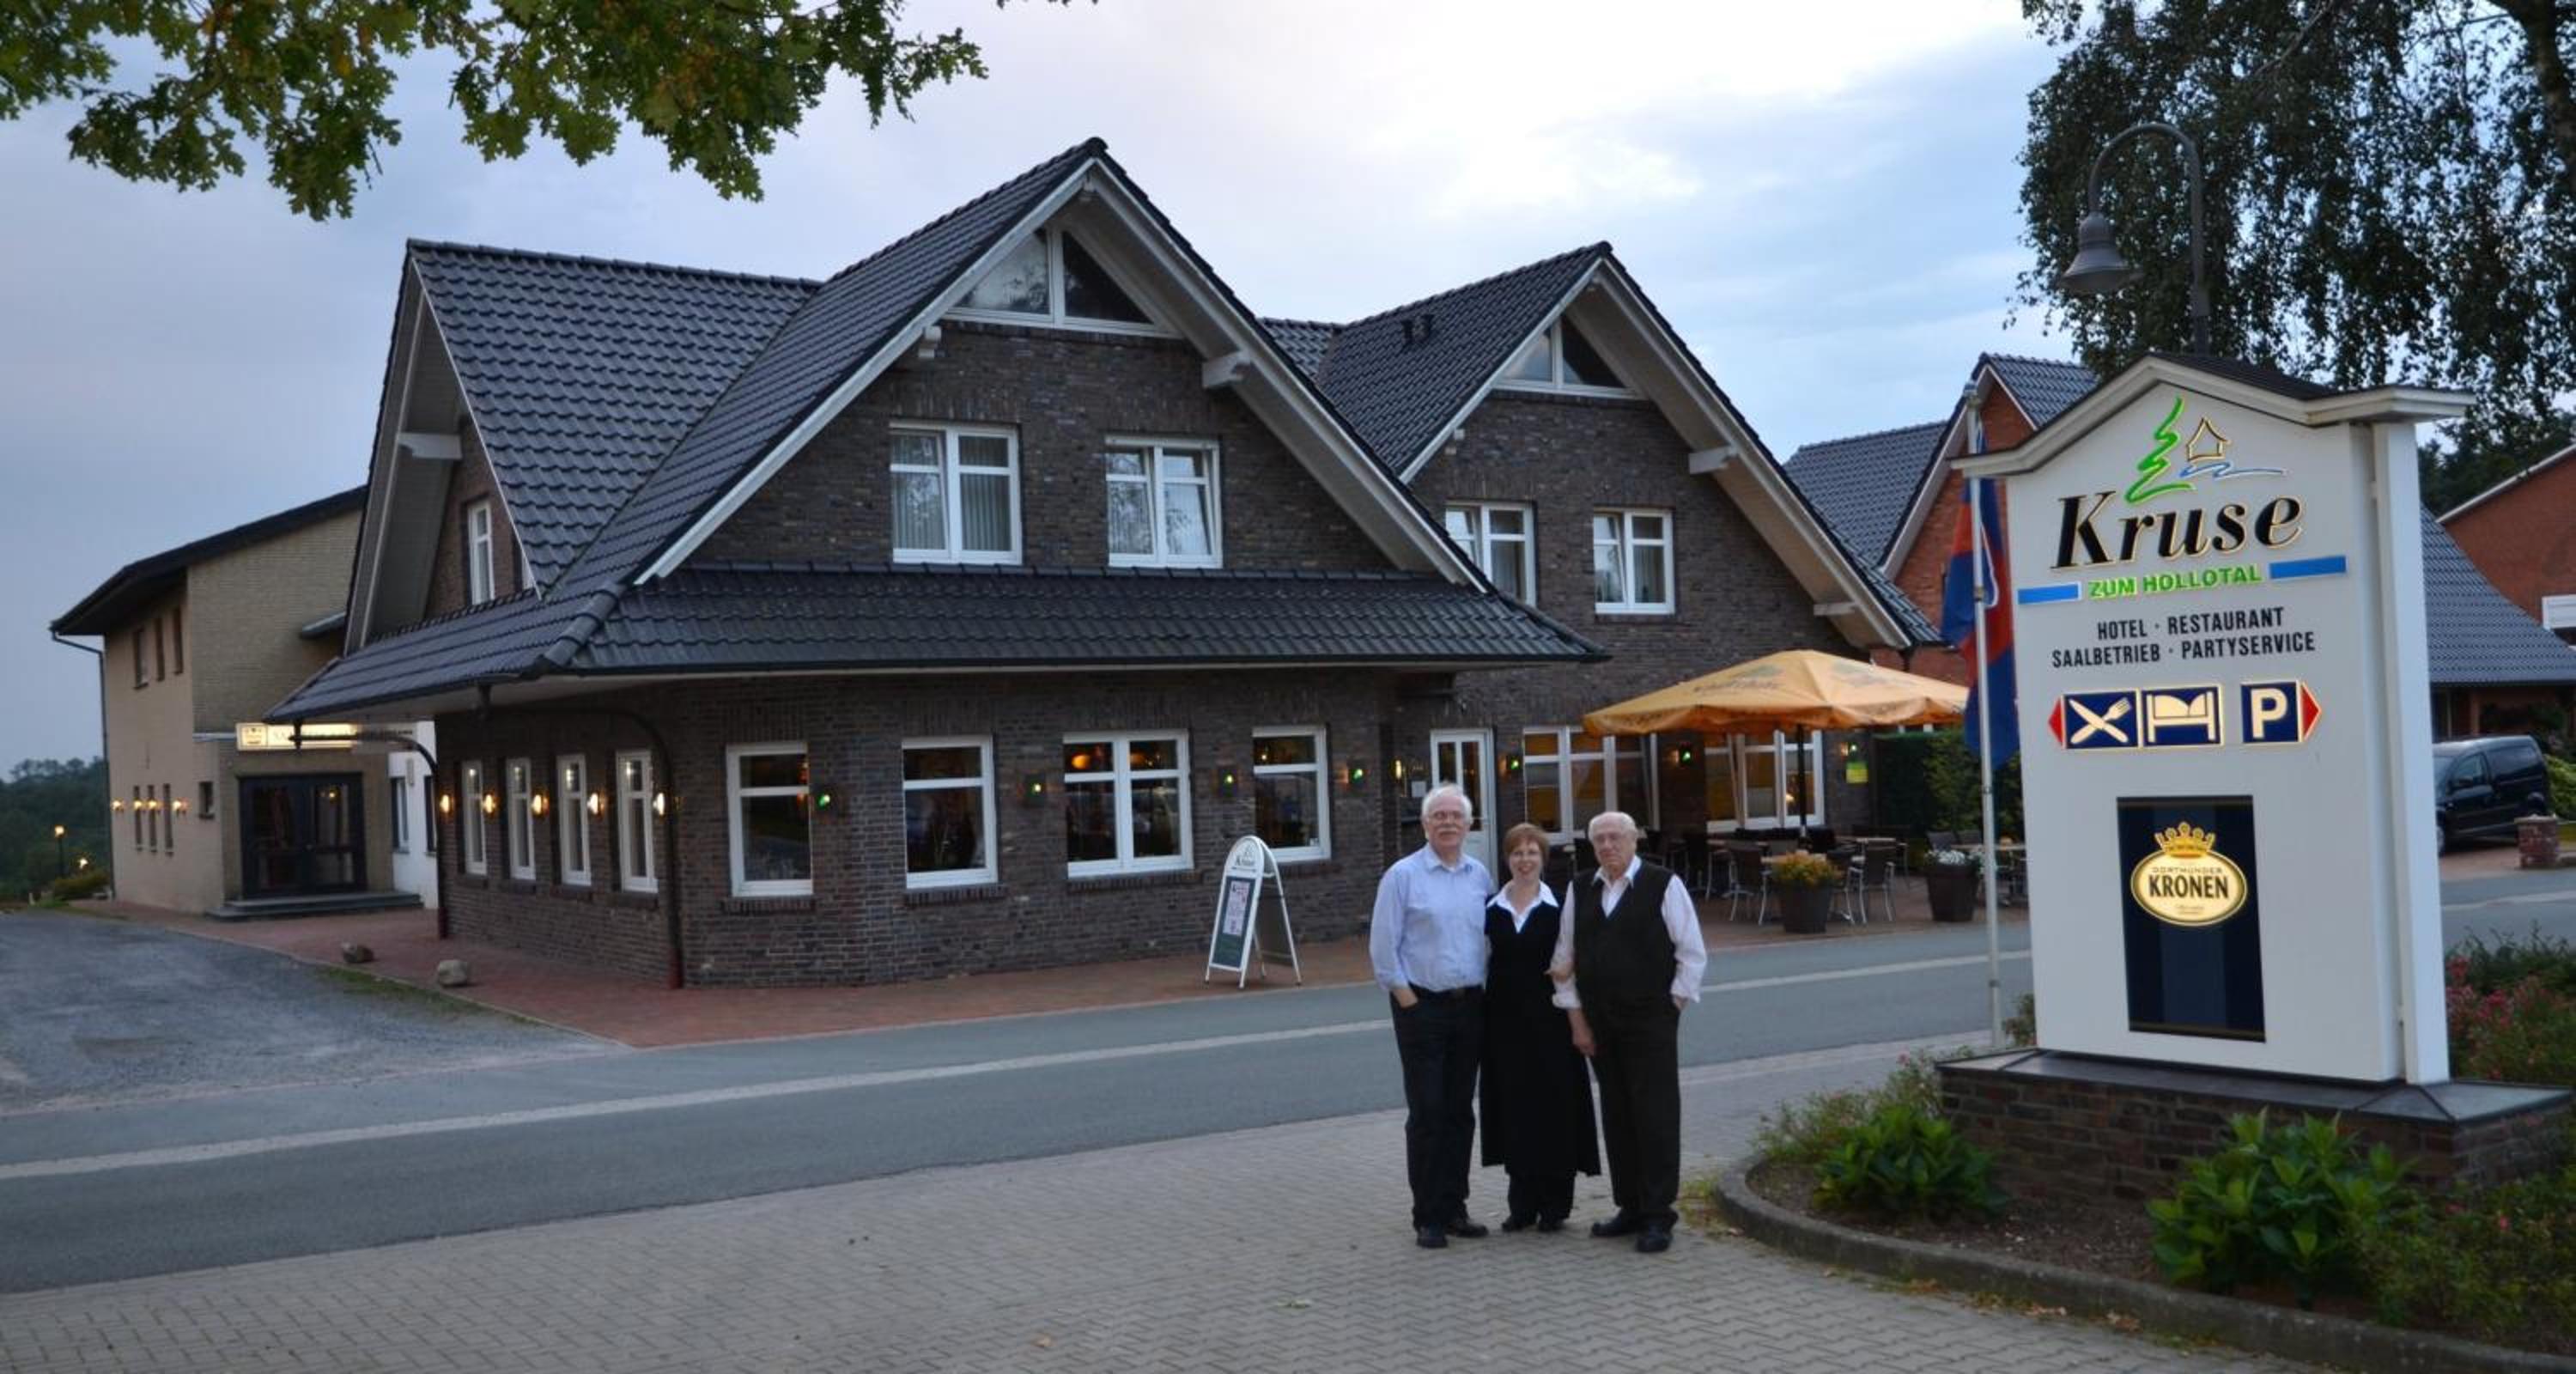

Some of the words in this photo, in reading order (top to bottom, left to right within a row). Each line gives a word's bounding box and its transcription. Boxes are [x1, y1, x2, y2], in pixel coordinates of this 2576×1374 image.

[2050, 490, 2305, 570] Kruse
[2088, 572, 2137, 600] ZUM
[2142, 564, 2261, 593] HOLLOTAL
[2097, 617, 2147, 641] HOTEL
[2167, 606, 2285, 635] RESTAURANT
[2051, 644, 2161, 669] SAALBETRIEB
[2181, 631, 2316, 660] PARTYSERVICE
[2251, 688, 2288, 739] P
[2148, 874, 2229, 899] KRONEN
